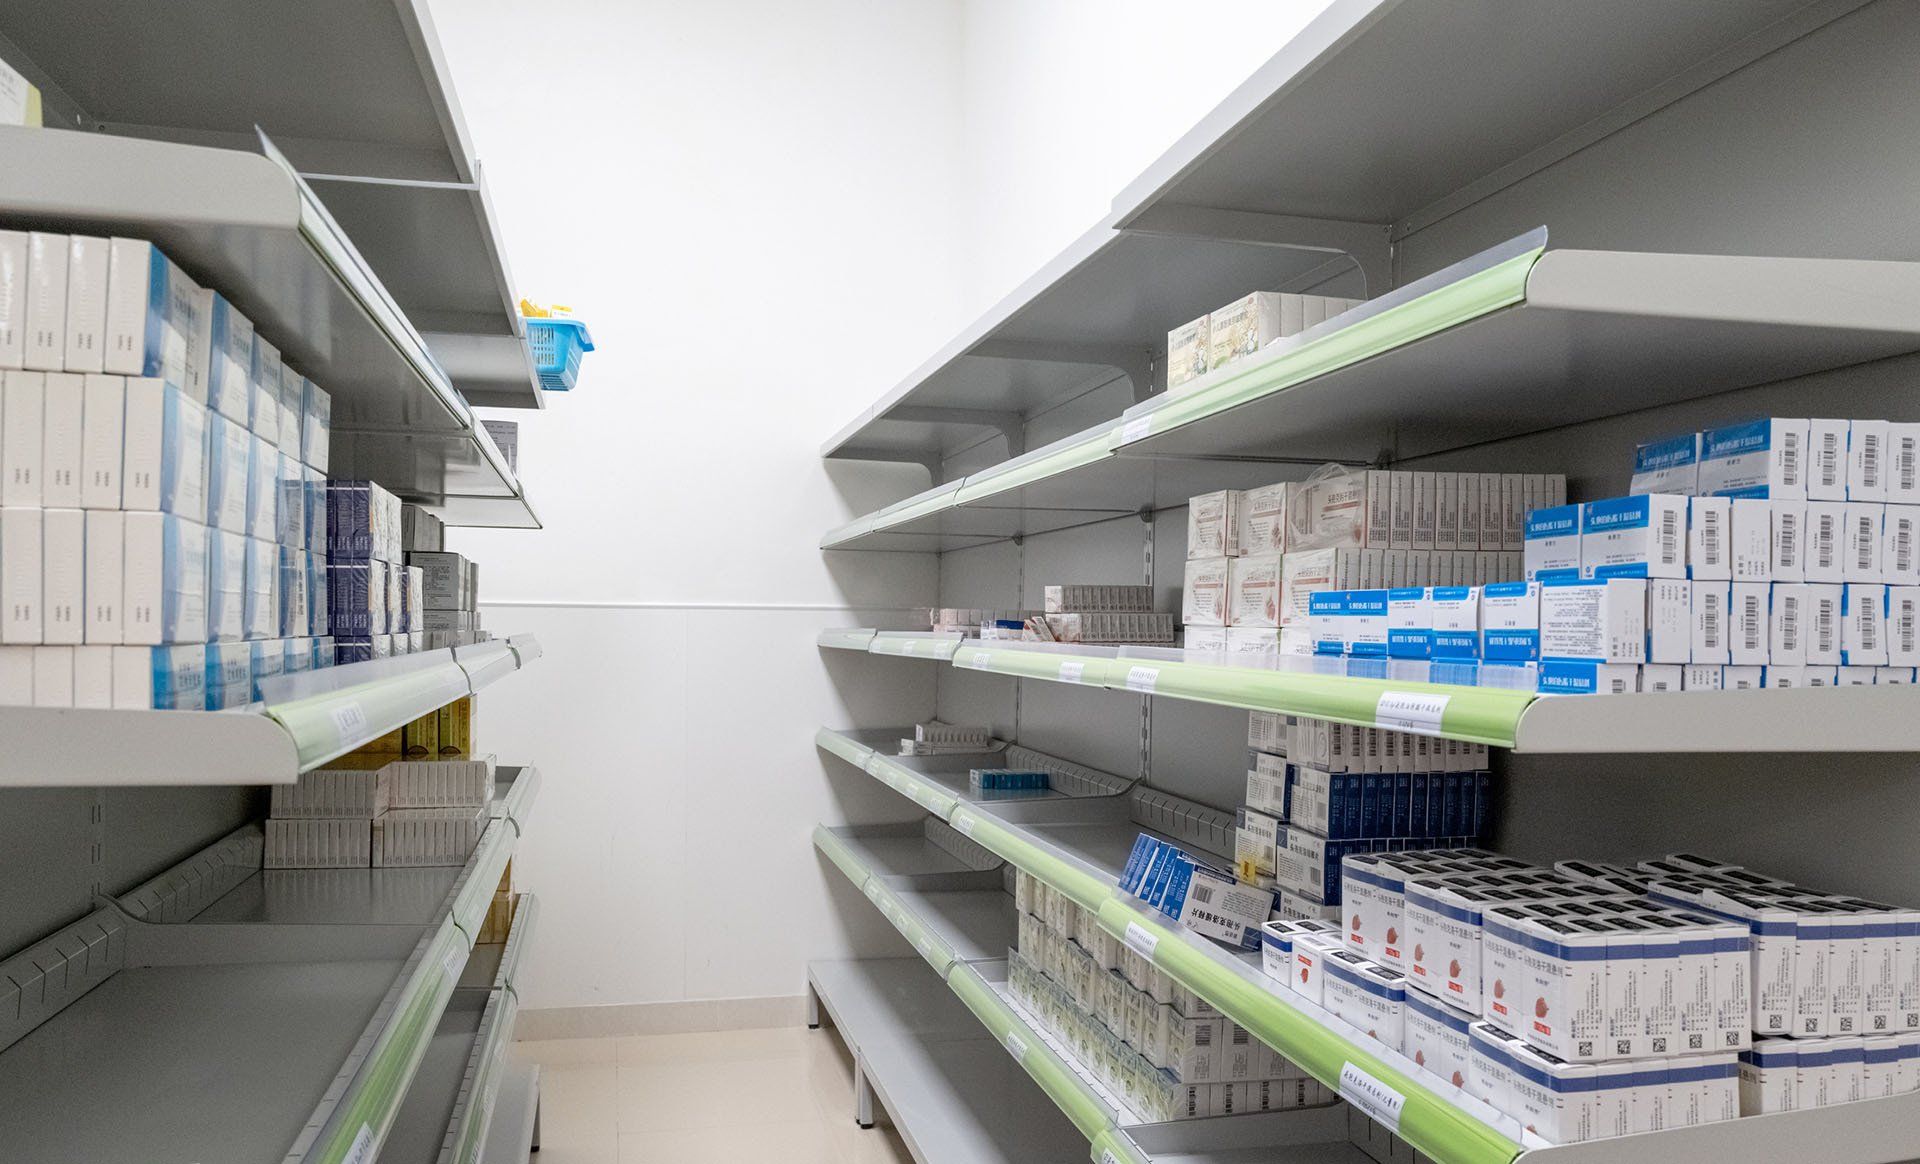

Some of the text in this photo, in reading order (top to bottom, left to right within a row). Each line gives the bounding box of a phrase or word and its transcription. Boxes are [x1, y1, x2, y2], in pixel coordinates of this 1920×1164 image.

[1192, 908, 1240, 931] 头孢克洛缓释片
